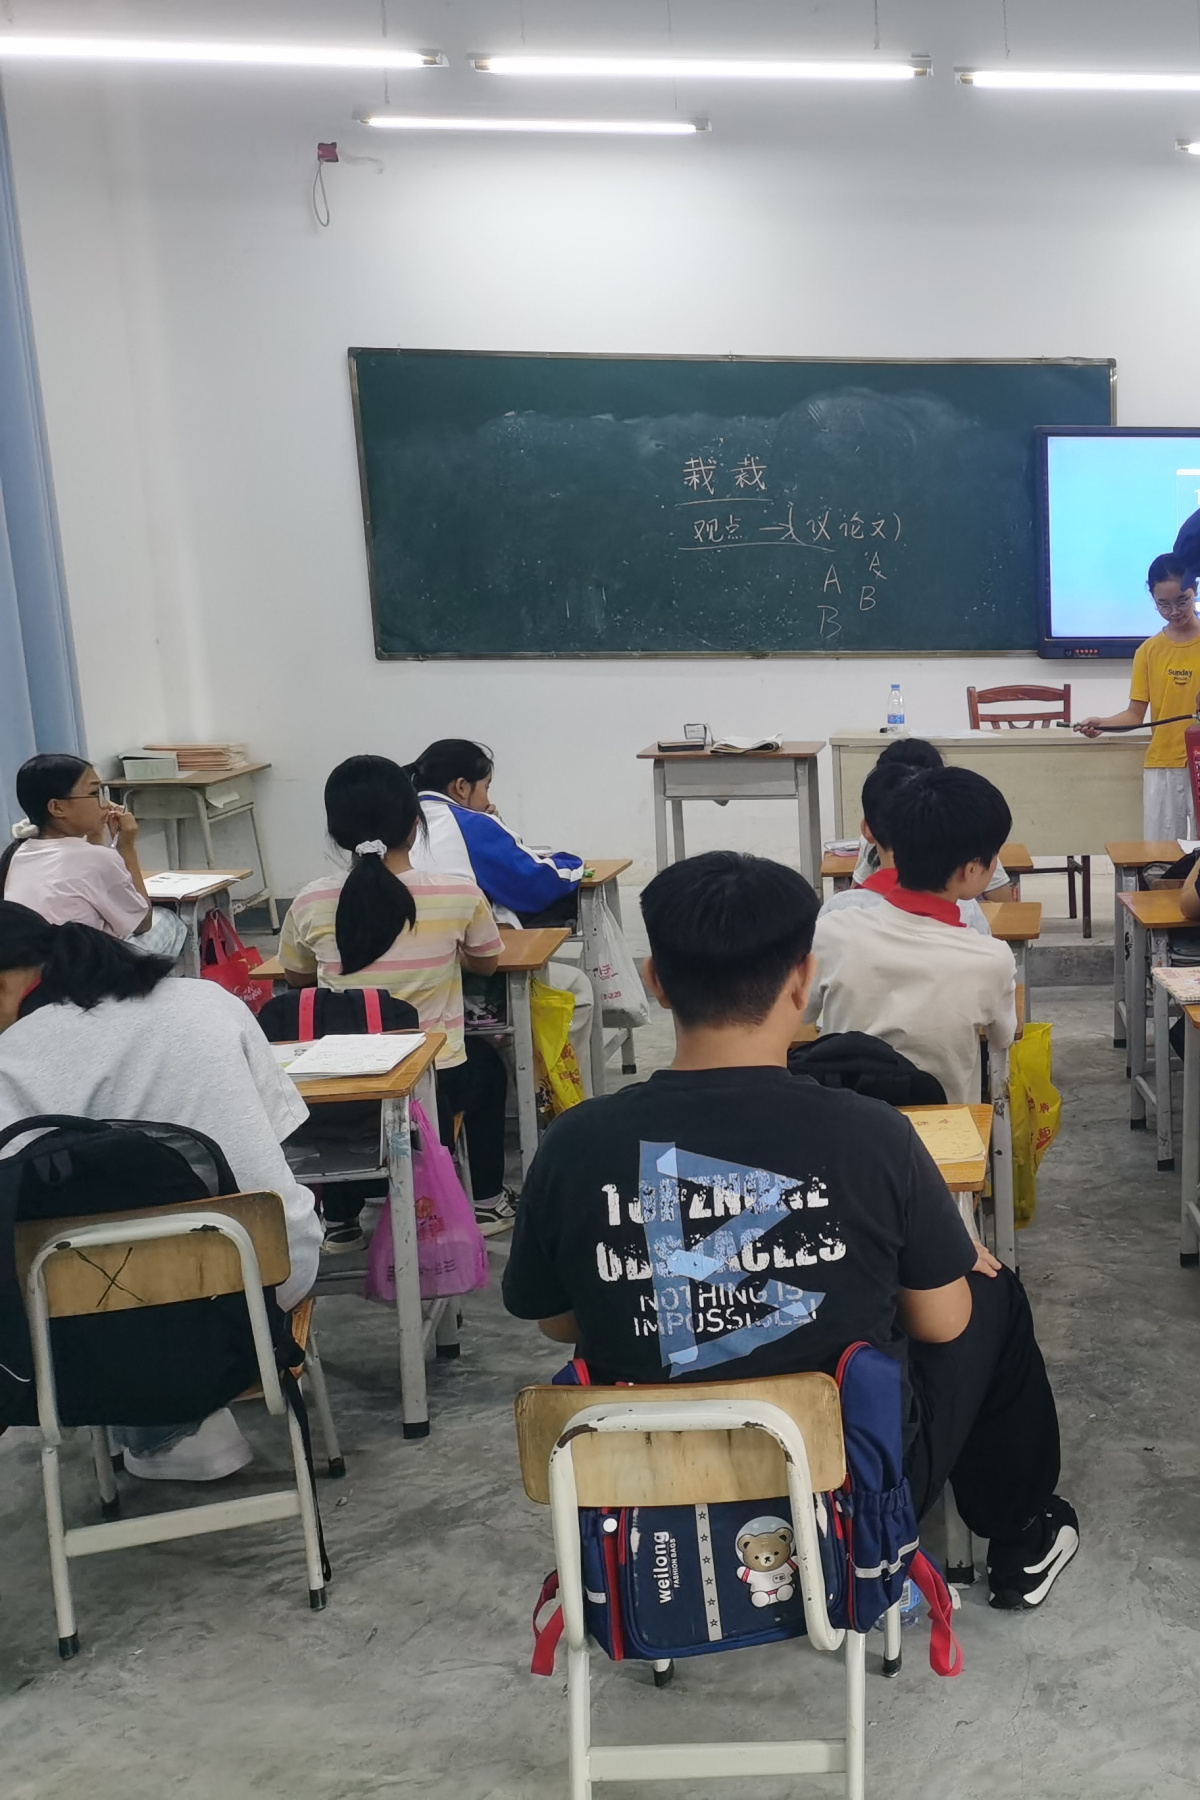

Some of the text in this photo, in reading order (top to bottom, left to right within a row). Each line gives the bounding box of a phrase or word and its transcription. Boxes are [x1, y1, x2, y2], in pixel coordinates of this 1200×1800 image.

[823, 563, 841, 594] A
[859, 586, 876, 611] B
[1168, 669, 1193, 678] Sunday
[639, 1282, 768, 1312] NOTHING
[652, 1530, 671, 1604] weilong
[669, 1538, 680, 1588] FASHION BAGS
